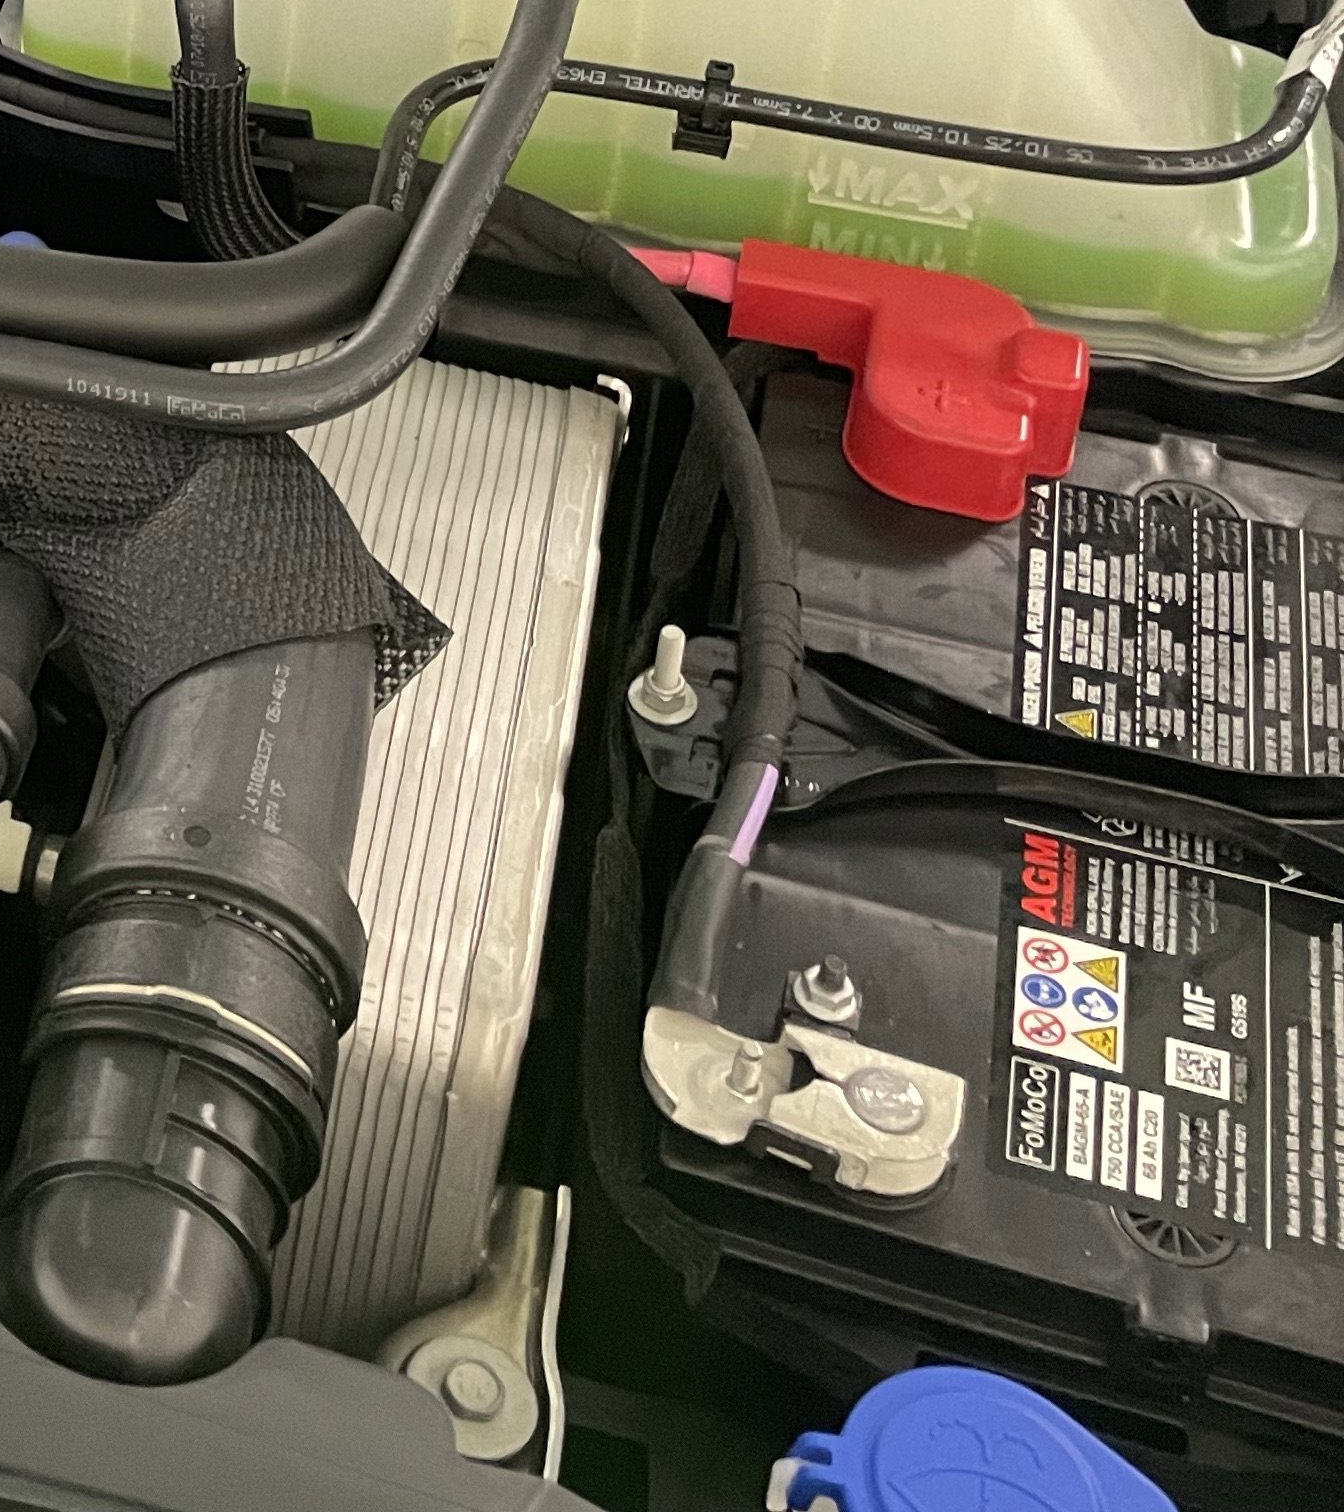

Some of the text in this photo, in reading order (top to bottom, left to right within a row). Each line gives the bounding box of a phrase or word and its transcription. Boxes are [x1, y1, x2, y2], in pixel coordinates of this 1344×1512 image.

[616, 72, 705, 102] ARNITEL
[835, 158, 980, 220] MAX
[809, 221, 921, 266] MIN
[1020, 833, 1059, 925] AGM
[1182, 981, 1215, 1031] MF
[1018, 1063, 1049, 1164] FoMoCo
[1107, 1089, 1126, 1182] 750 CCA/SAE
[1143, 1108, 1159, 1135] C20
[1143, 1136, 1157, 1161] Ah
